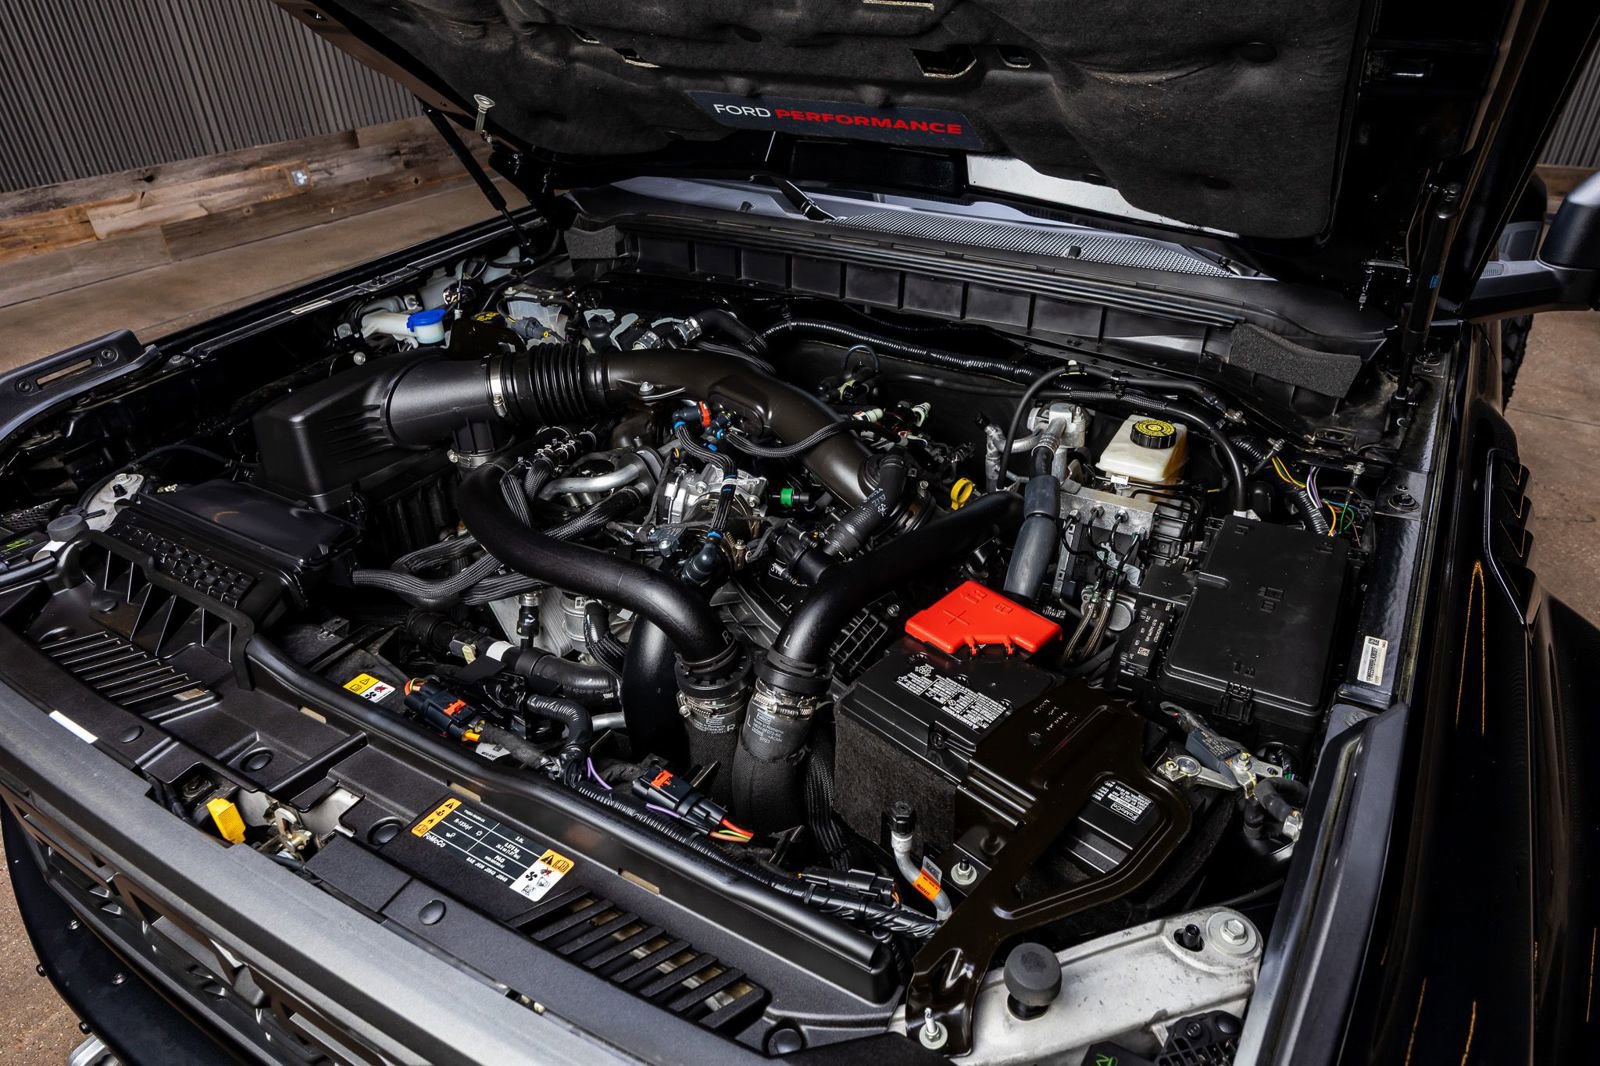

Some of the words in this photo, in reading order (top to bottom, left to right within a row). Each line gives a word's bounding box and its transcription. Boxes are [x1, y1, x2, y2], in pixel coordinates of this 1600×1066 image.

[713, 103, 771, 118] FORD
[774, 108, 963, 135] PERFORMANCE
[423, 832, 446, 848] FoMoCo
